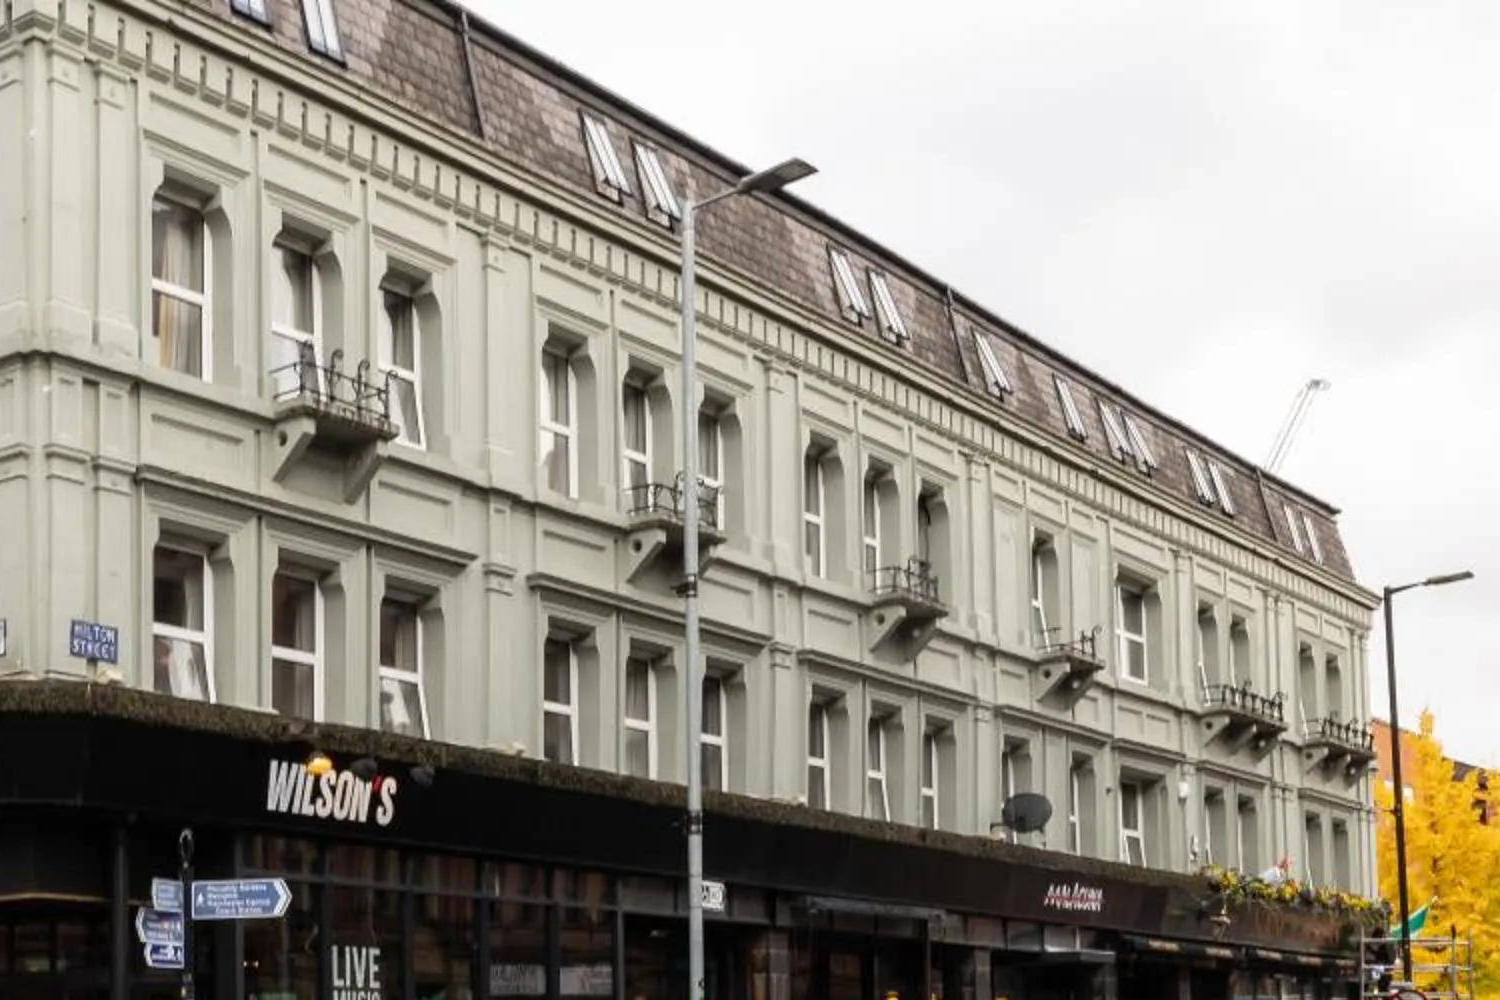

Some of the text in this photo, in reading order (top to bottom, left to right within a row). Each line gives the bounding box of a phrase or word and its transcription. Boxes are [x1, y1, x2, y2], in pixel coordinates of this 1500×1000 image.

[72, 639, 116, 661] STREET
[73, 623, 116, 645] HILTON
[266, 758, 398, 827] WILSON'S
[331, 944, 381, 989] LIVE
